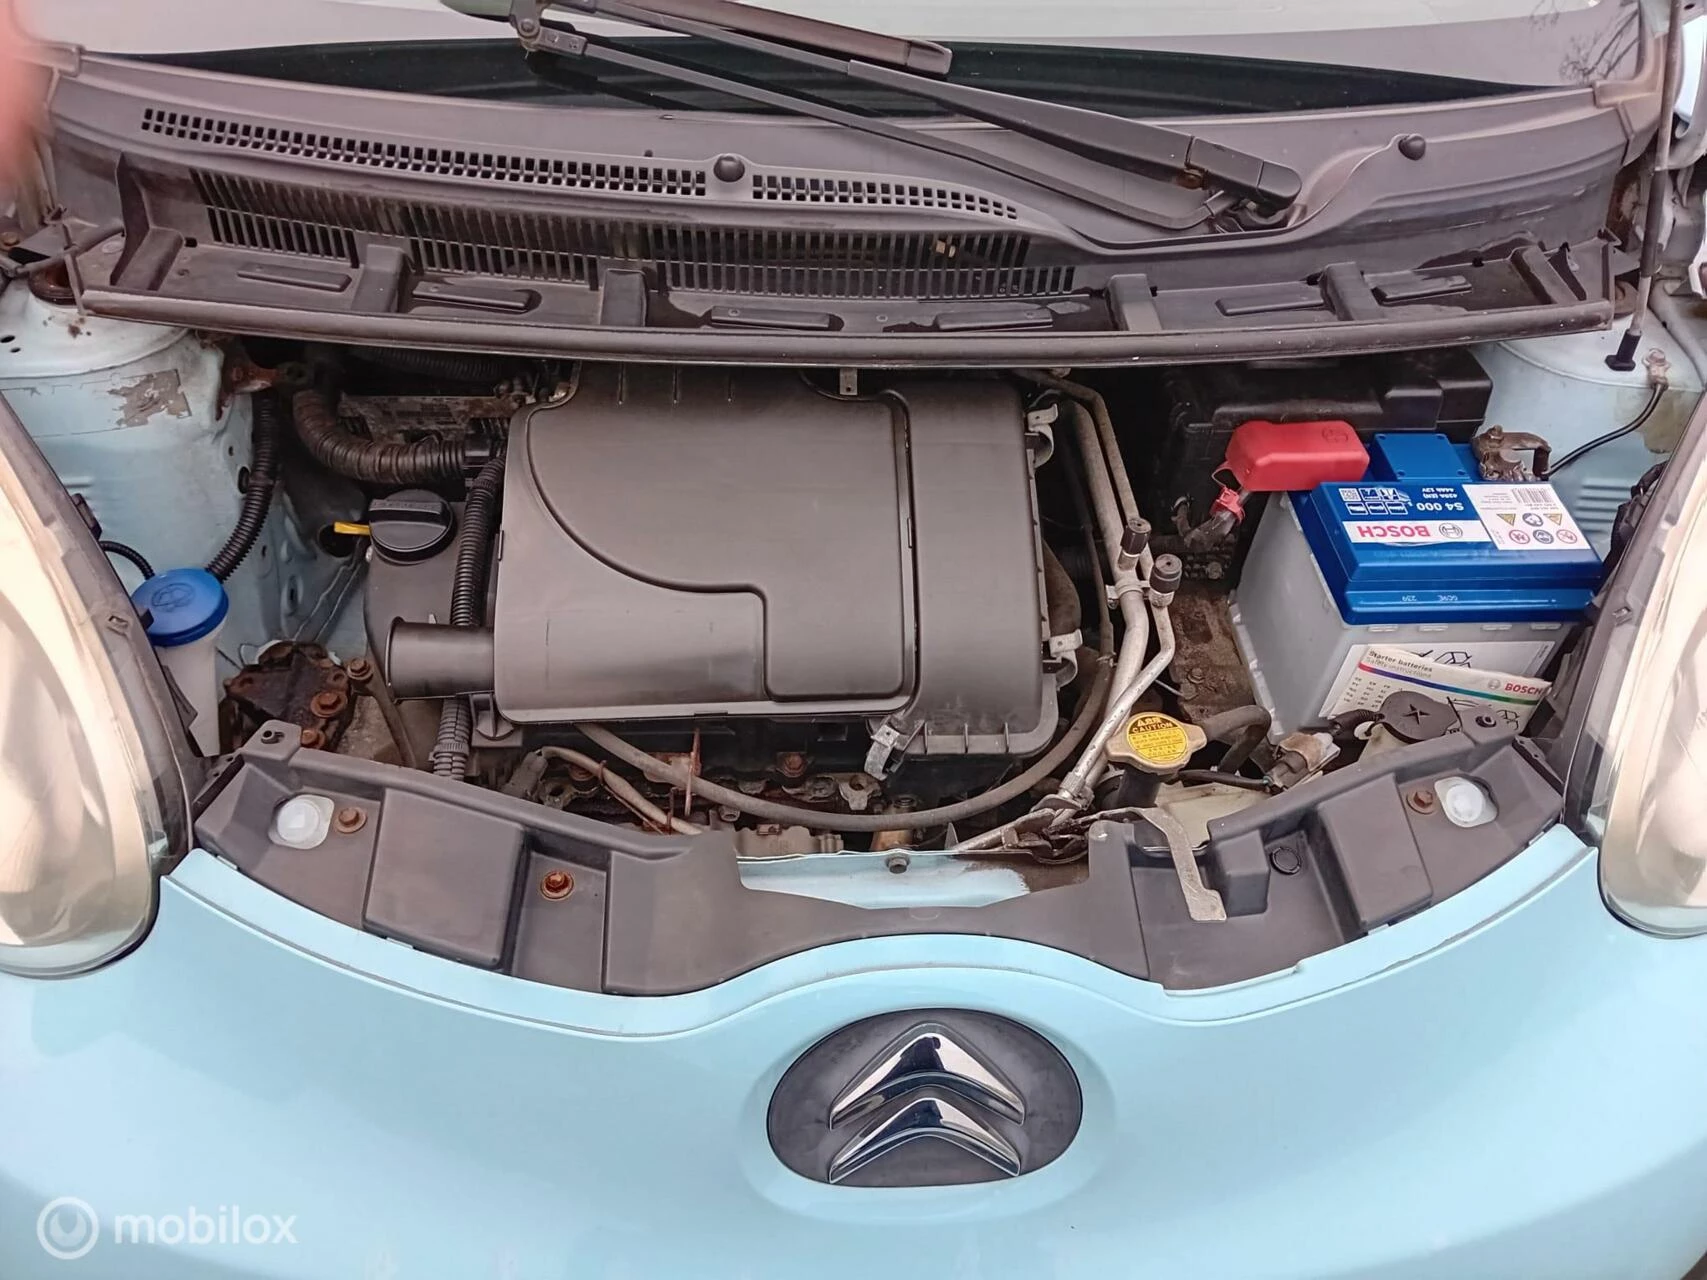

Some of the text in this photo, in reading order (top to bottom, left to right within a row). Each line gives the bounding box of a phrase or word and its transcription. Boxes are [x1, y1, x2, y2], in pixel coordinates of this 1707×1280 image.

[1416, 502, 1464, 511] S4 000
[1357, 525, 1431, 538] BOSCH
[1368, 650, 1433, 673] Starter batteries
[1505, 683, 1542, 695] BOSCH
[1132, 722, 1172, 734] CAUTION
